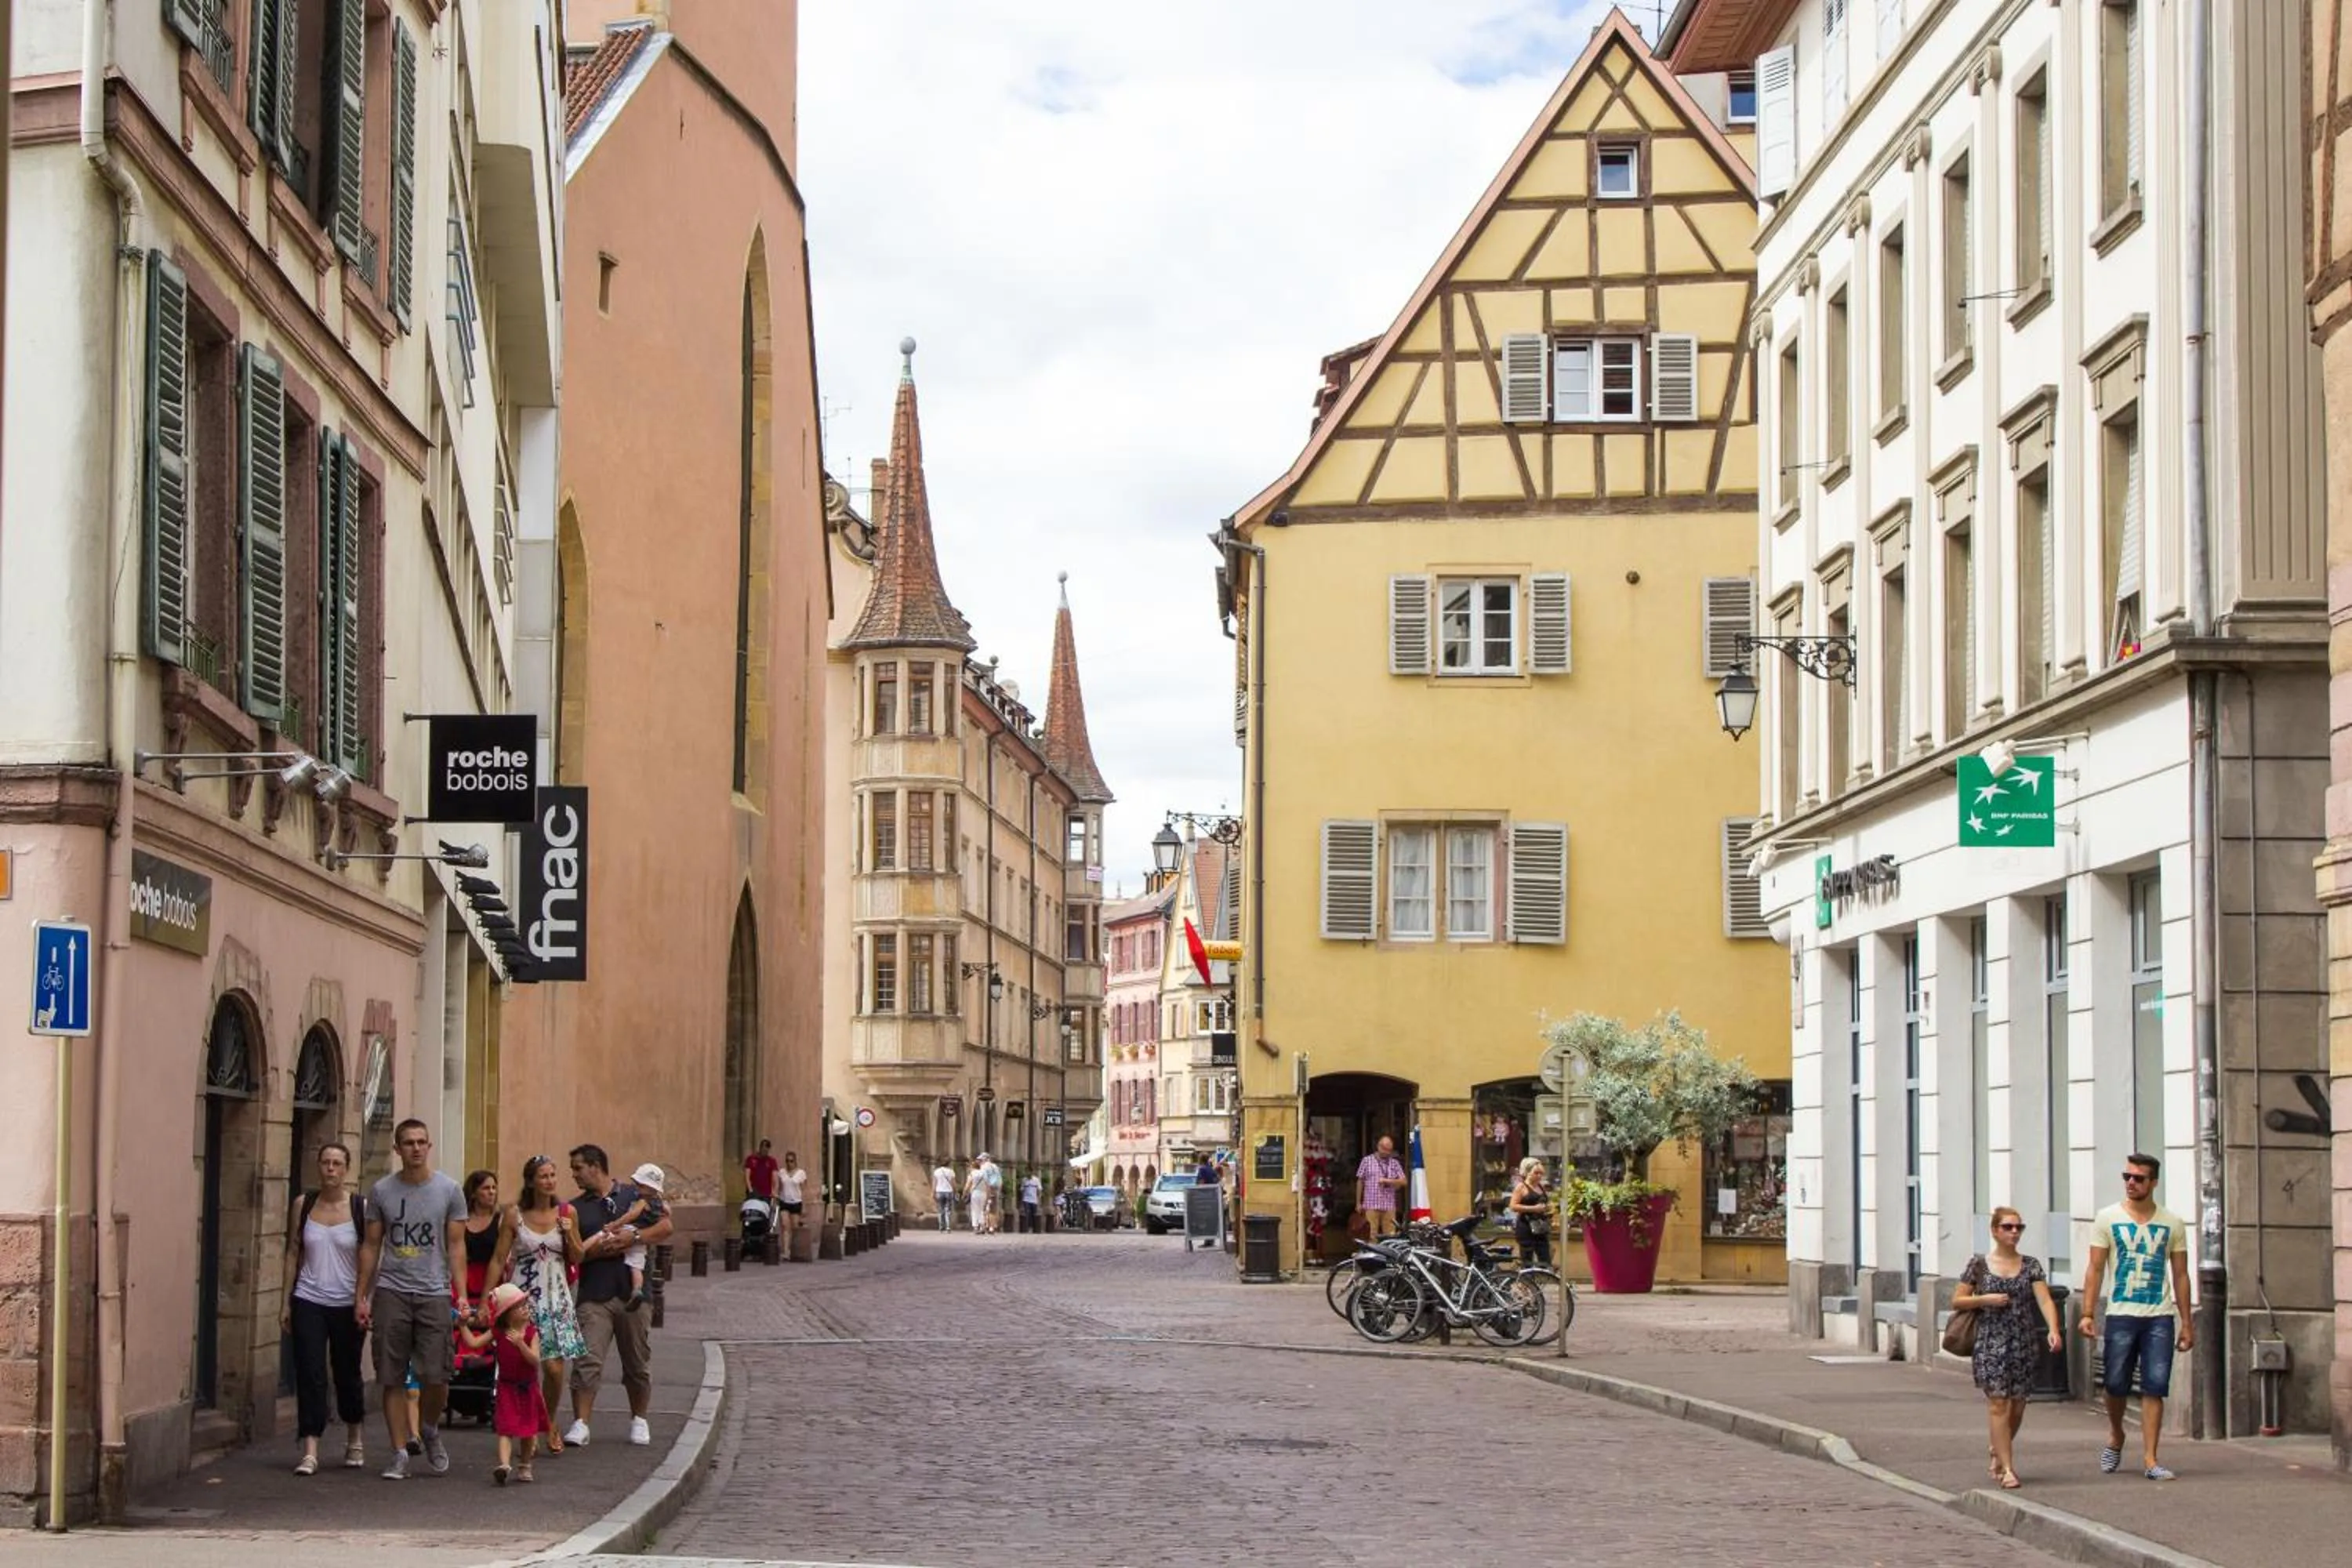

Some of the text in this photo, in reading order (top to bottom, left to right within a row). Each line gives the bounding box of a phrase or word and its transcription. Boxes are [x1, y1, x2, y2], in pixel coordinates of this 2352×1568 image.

[447, 746, 528, 768] roche
[446, 769, 528, 790] bobois
[528, 804, 579, 962] fnac
[130, 876, 197, 931] oche bobois
[394, 1198, 405, 1221] J
